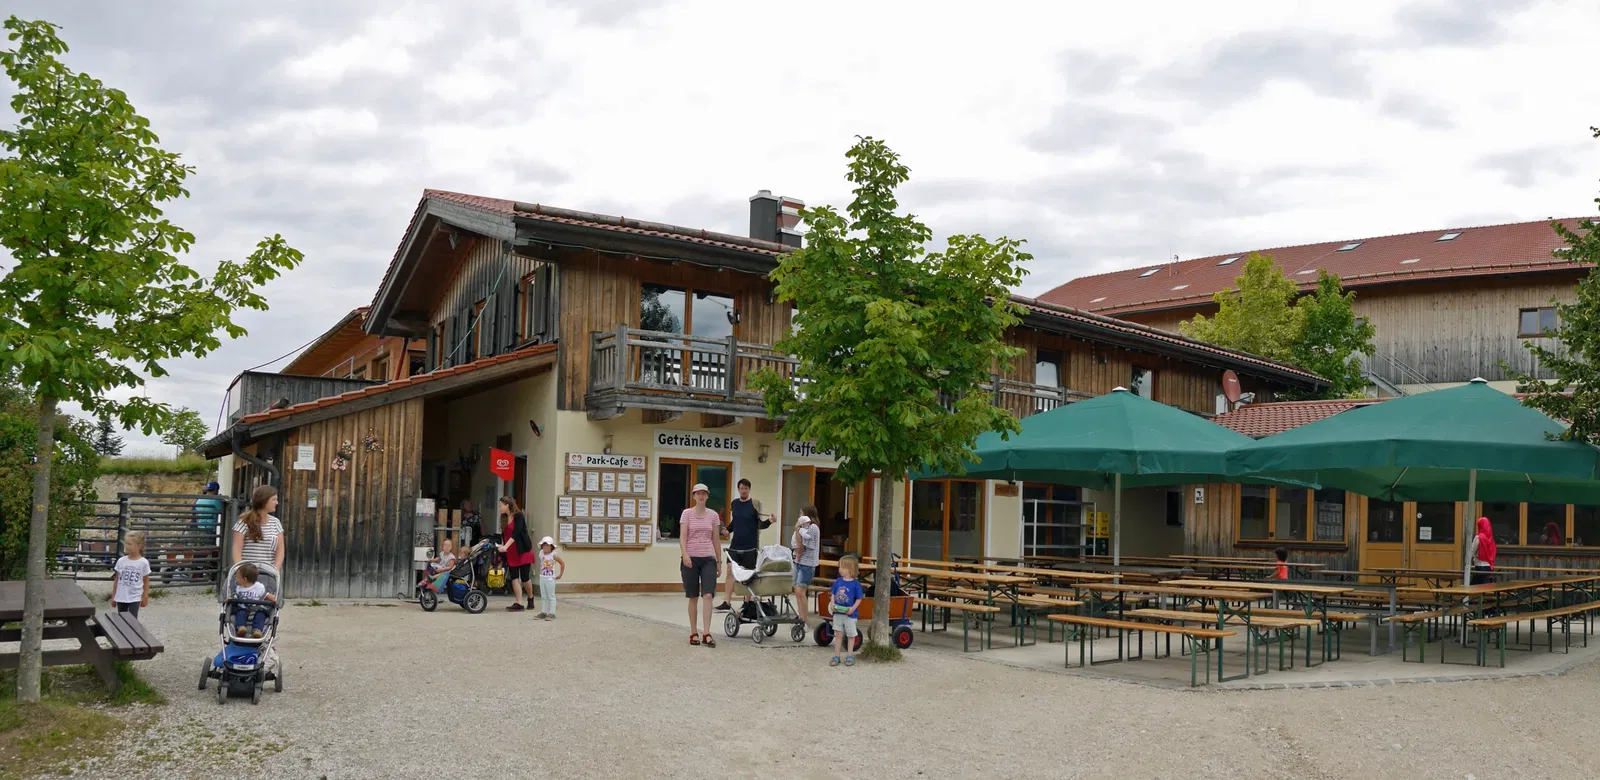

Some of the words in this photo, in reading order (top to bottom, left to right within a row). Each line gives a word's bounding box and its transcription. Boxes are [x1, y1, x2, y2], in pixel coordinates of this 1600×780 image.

[658, 433, 713, 448] Getränke
[714, 437, 722, 449] &
[723, 436, 739, 450] Eis
[587, 456, 629, 468] Park-Cafe
